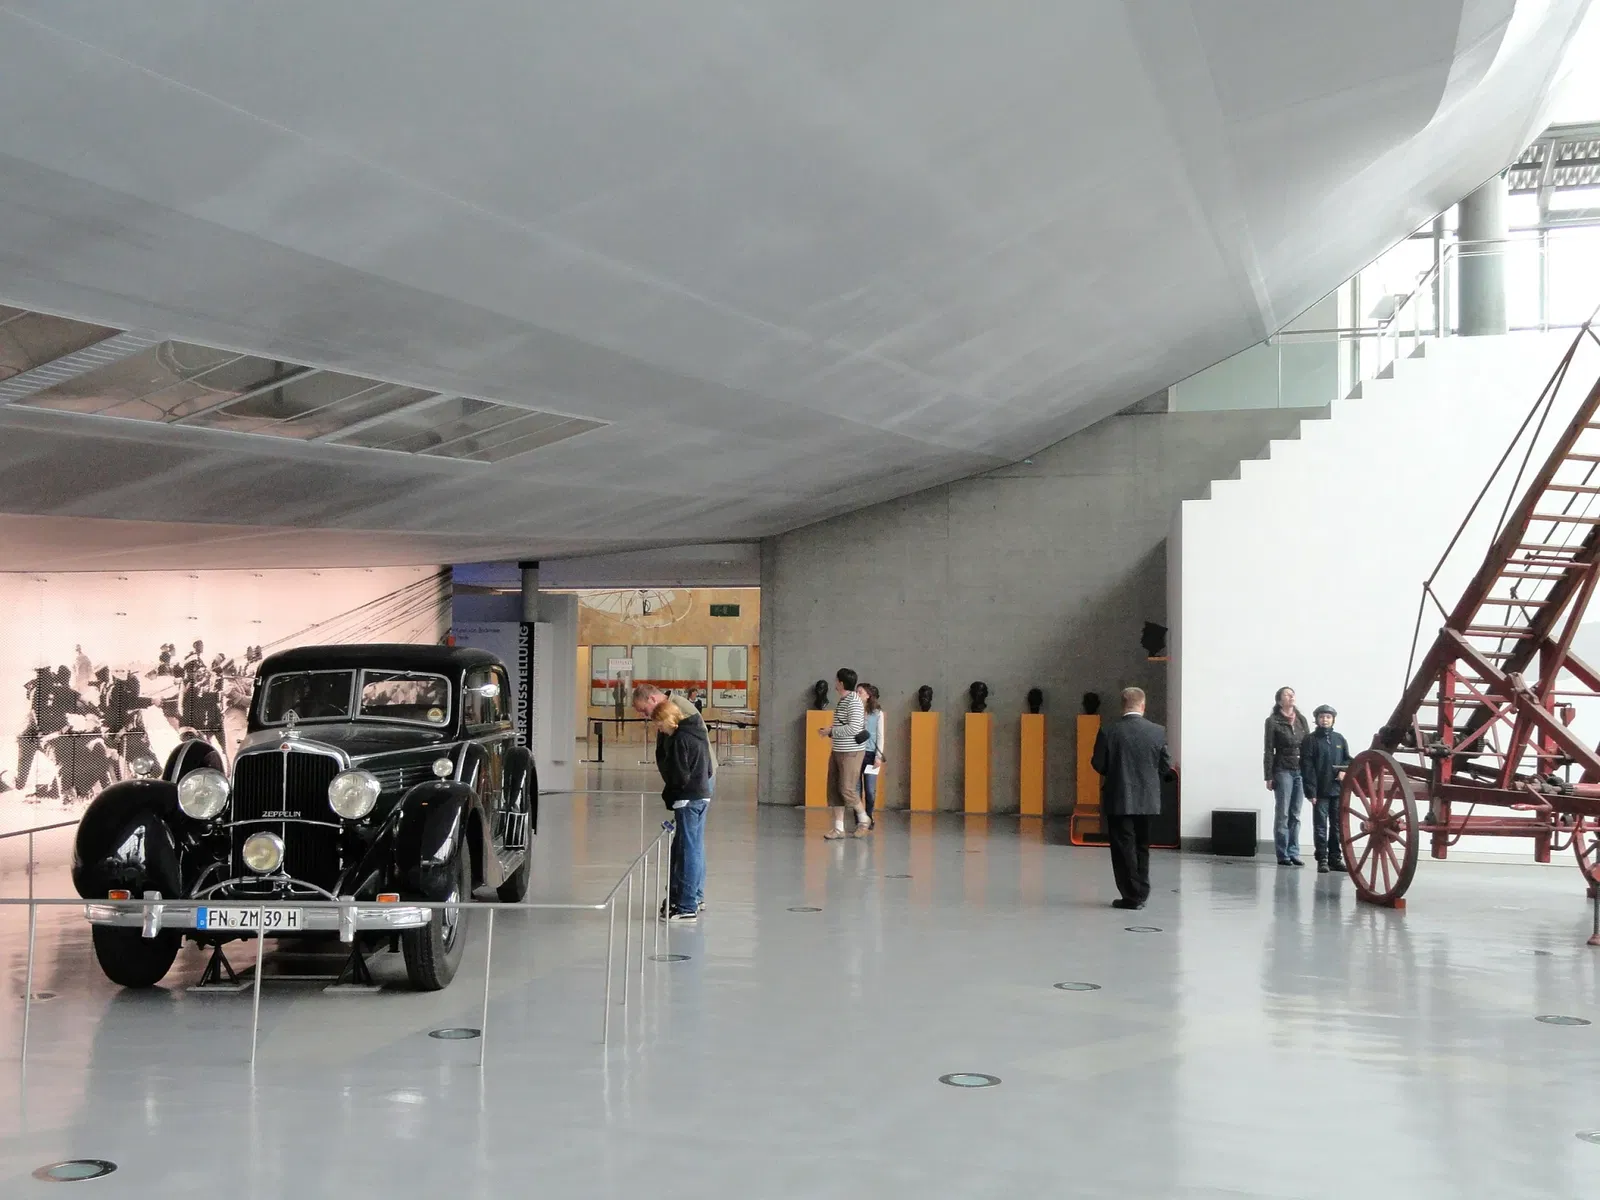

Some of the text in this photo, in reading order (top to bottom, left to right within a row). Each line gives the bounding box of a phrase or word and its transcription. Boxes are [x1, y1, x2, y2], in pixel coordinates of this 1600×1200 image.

[515, 625, 529, 748] UERAUSSTELLUNG
[261, 810, 302, 818] ZEPPELIN
[208, 910, 297, 927] FN ZM 39 H
